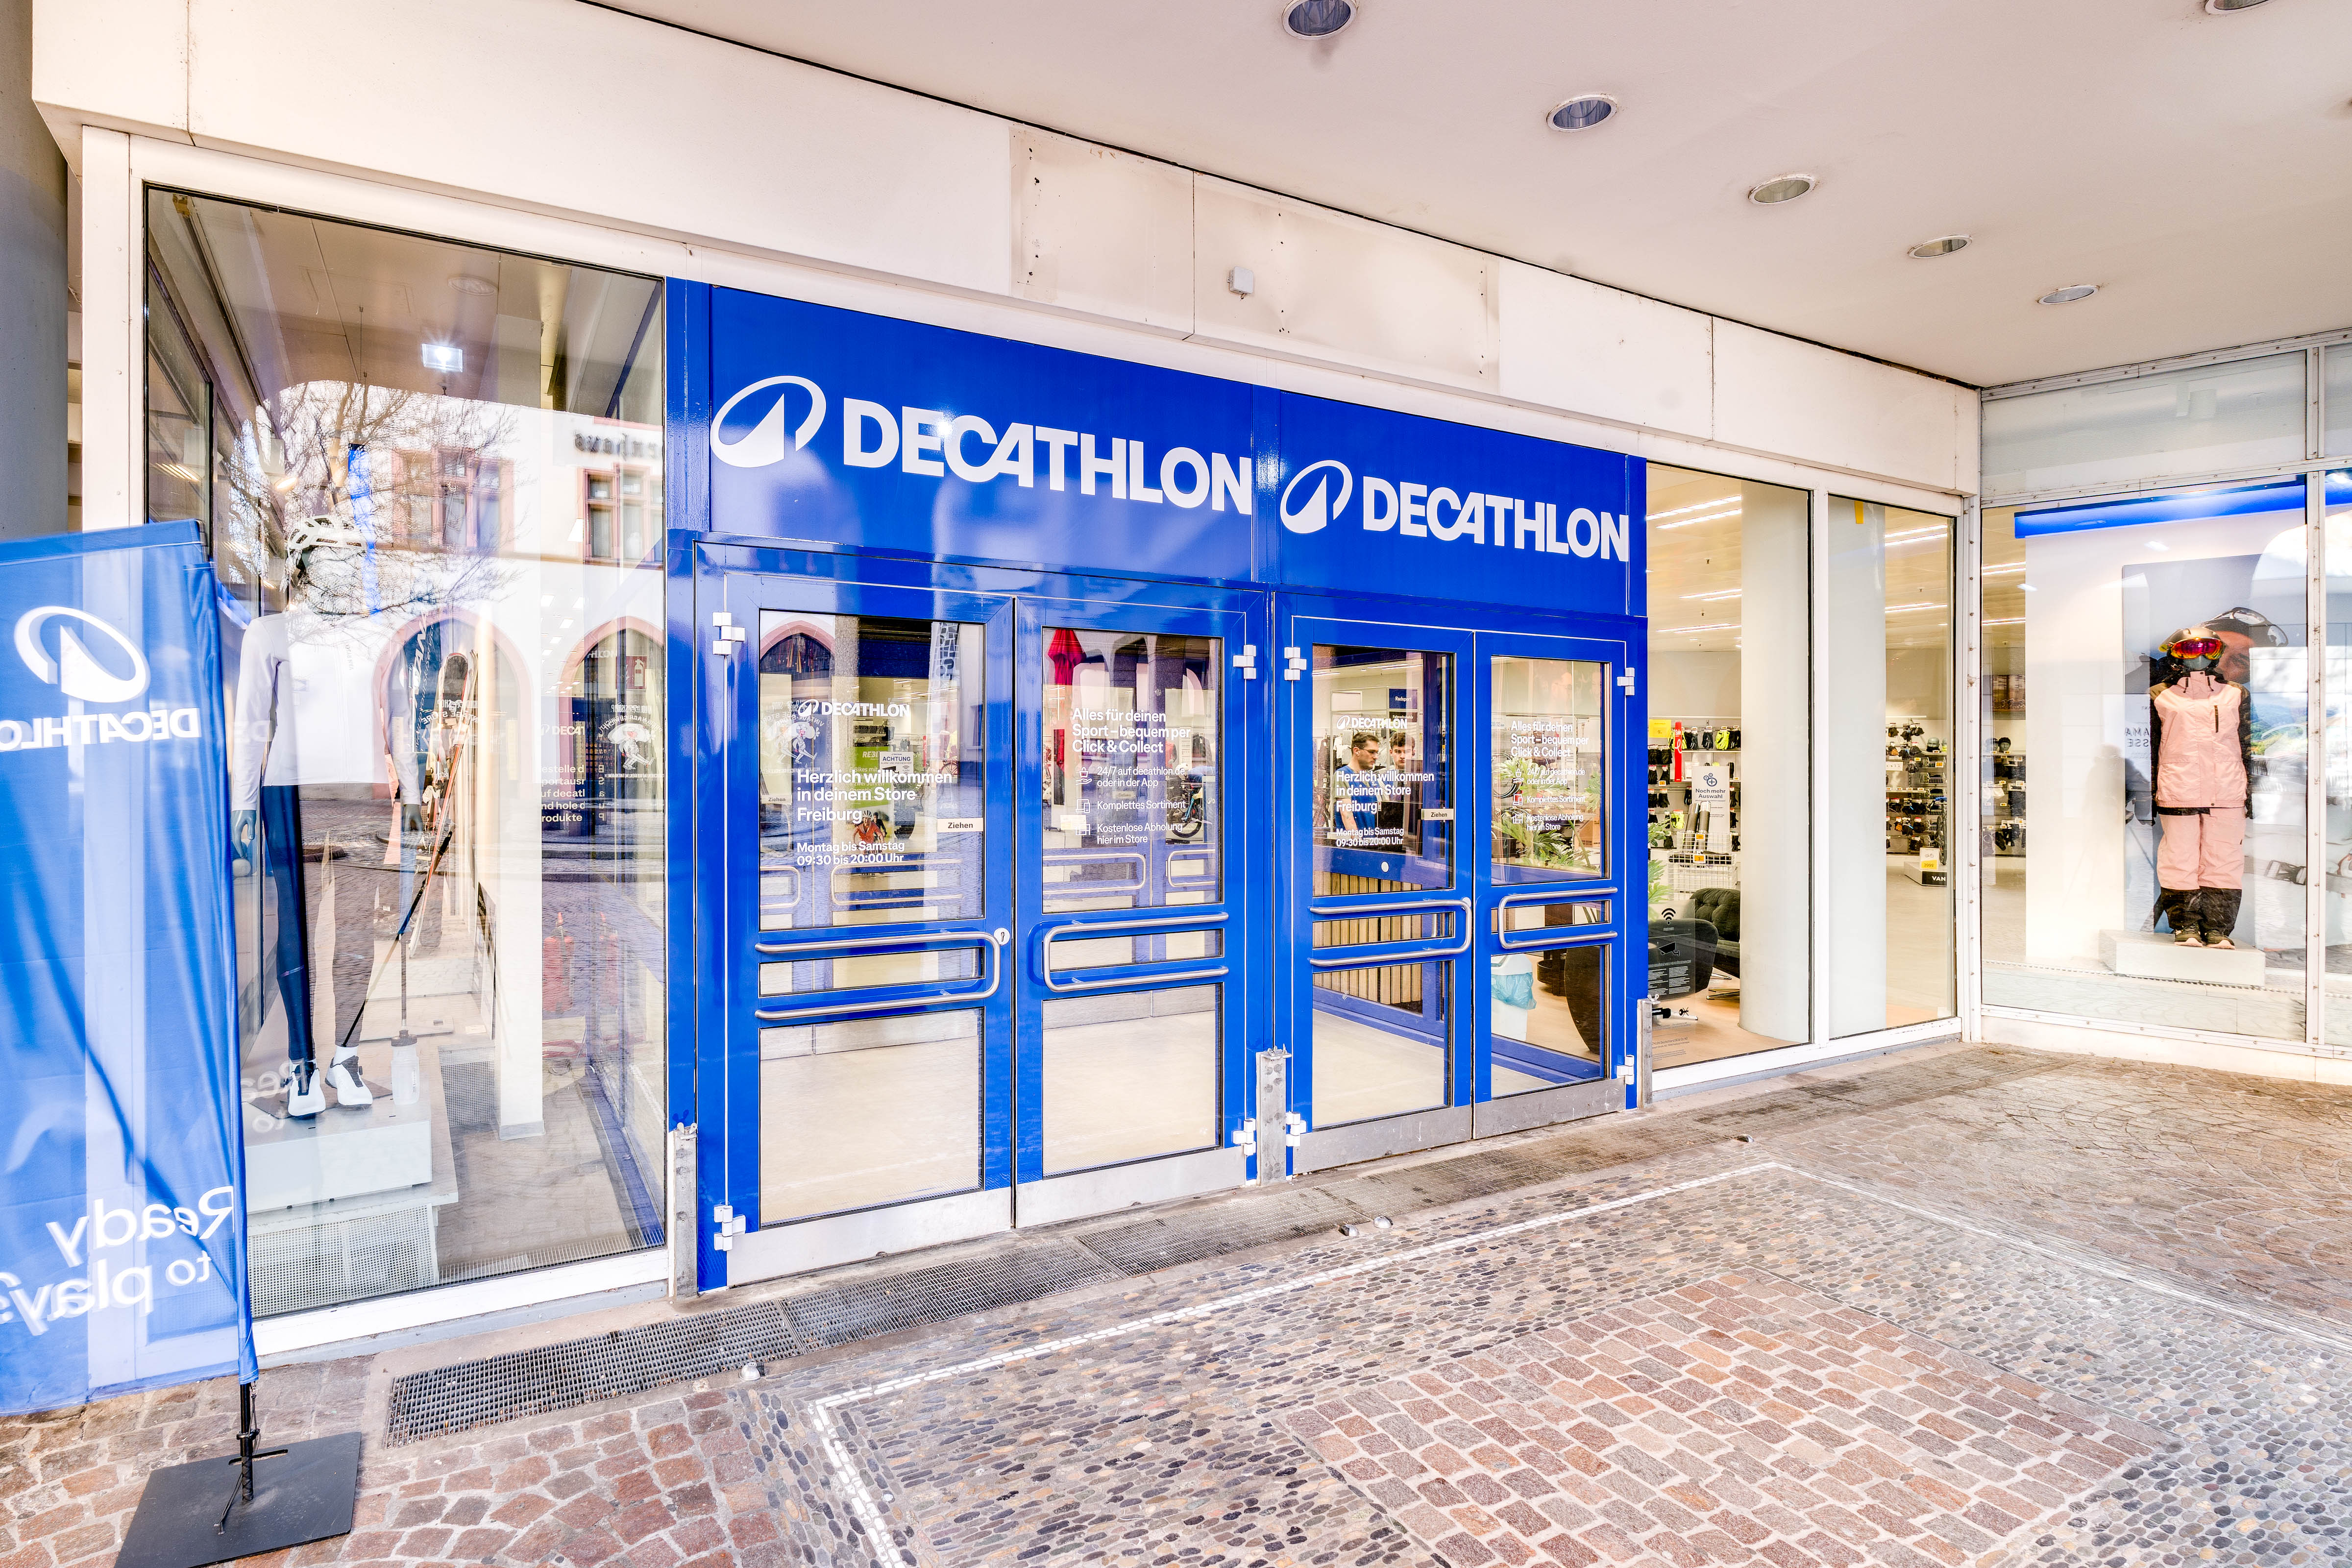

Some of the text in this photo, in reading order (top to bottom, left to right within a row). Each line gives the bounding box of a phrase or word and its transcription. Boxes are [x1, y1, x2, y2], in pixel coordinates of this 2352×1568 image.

[843, 397, 1252, 515] DECATHLON
[1363, 475, 1628, 563] DECATHLON
[822, 701, 910, 717] DECATHLON
[1072, 708, 1166, 722] Alles für deinen
[1352, 717, 1407, 729] DECATHLON
[1511, 720, 1573, 732] Alles für deinen
[1072, 723, 1109, 739] Sport
[1120, 725, 1169, 740] bequem
[1171, 728, 1191, 740] per
[1072, 740, 1164, 753] Click & Collect
[1511, 733, 1535, 746] Sport
[1542, 735, 1575, 747] bequem
[1576, 737, 1589, 748] per
[1511, 746, 1571, 757] Click & Collect
[541, 764, 576, 773] estelle
[1097, 766, 1185, 776] 24/7 auf decathlon.de
[797, 770, 861, 784] Herzlich
[864, 769, 952, 784] willkommen
[1336, 770, 1435, 783] Herzlich willkommen
[1555, 777, 1568, 785] App
[1097, 778, 1158, 788] oder in der App
[541, 789, 551, 797] uf
[797, 786, 916, 802] in deinem Store
[1336, 784, 1412, 796] in deinem Store
[556, 801, 578, 809] hole
[1097, 800, 1186, 811] Komplettes Sortiment
[1527, 795, 1558, 804] Komplettes
[1336, 801, 1377, 814] Freiburg
[541, 813, 583, 822] rodukte
[797, 807, 862, 825] Freiburg
[1558, 813, 1584, 822] Abholung
[1097, 822, 1183, 833] Kostenlose Abholung
[1336, 827, 1404, 837] Montag bis Samstag
[1545, 823, 1561, 831] Store
[1097, 834, 1148, 844] hier im Store
[1336, 837, 1404, 847] 09:30 bis 20:00 Uhr
[797, 841, 905, 855] Montag bis Samstag
[797, 853, 905, 866] 09:30 bis 20:00 Uhr
